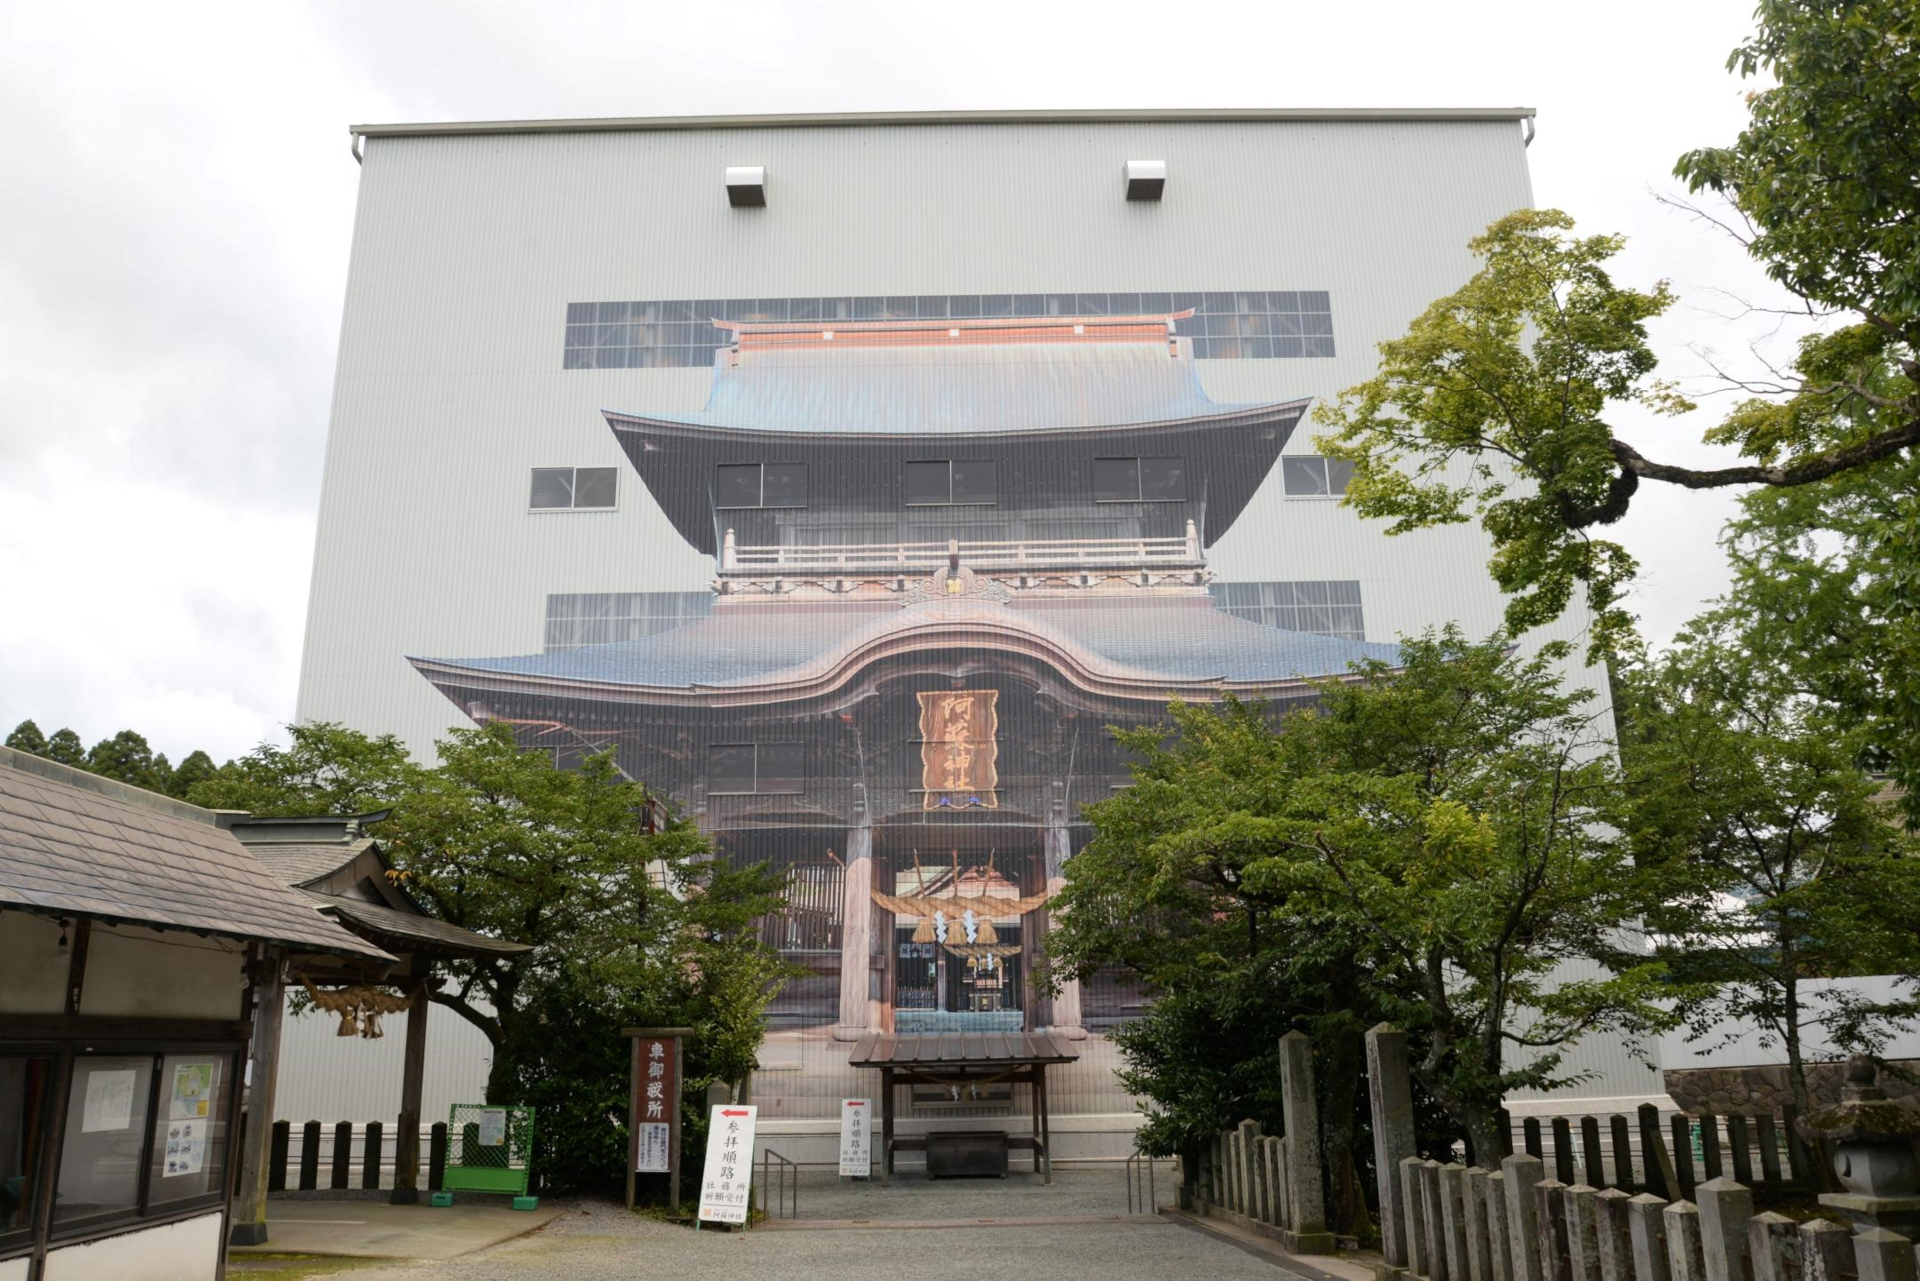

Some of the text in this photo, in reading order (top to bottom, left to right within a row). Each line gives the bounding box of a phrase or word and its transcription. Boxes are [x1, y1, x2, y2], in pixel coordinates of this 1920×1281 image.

[646, 1042, 665, 1119] 車御祓所
[720, 1120, 740, 1180] 参拝順路
[851, 1109, 862, 1149] 参拝順路
[705, 1193, 745, 1203] 祈願受付
